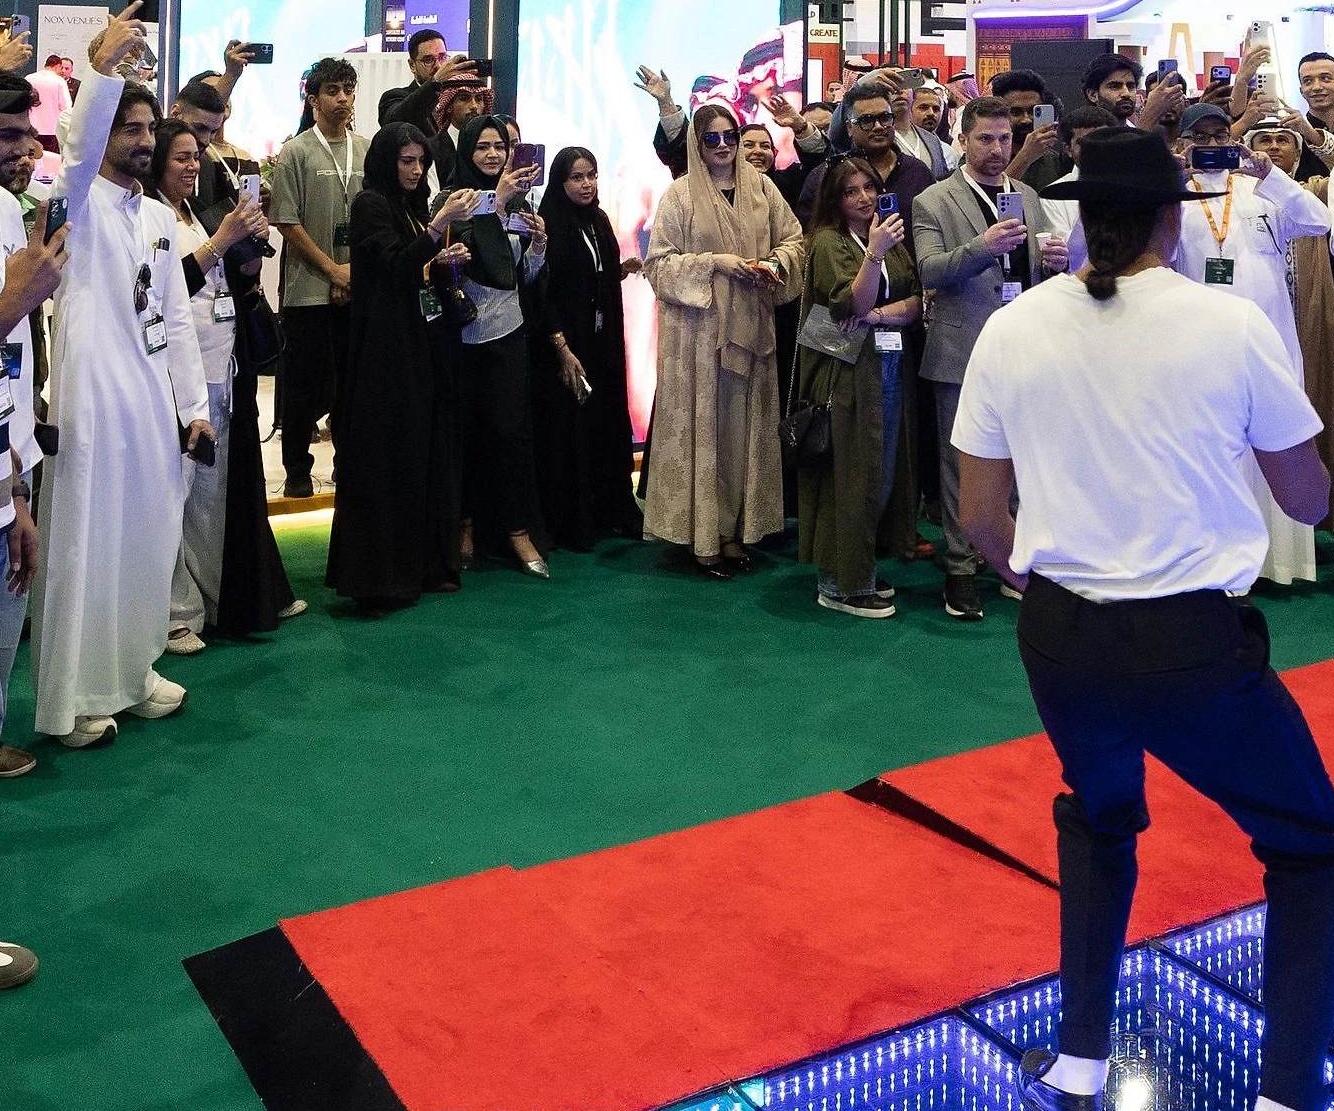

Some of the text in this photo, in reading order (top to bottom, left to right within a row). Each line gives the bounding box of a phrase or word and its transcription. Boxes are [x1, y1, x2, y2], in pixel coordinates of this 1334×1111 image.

[43, 15, 104, 25] NOX VENUES
[809, 29, 839, 38] CREATE
